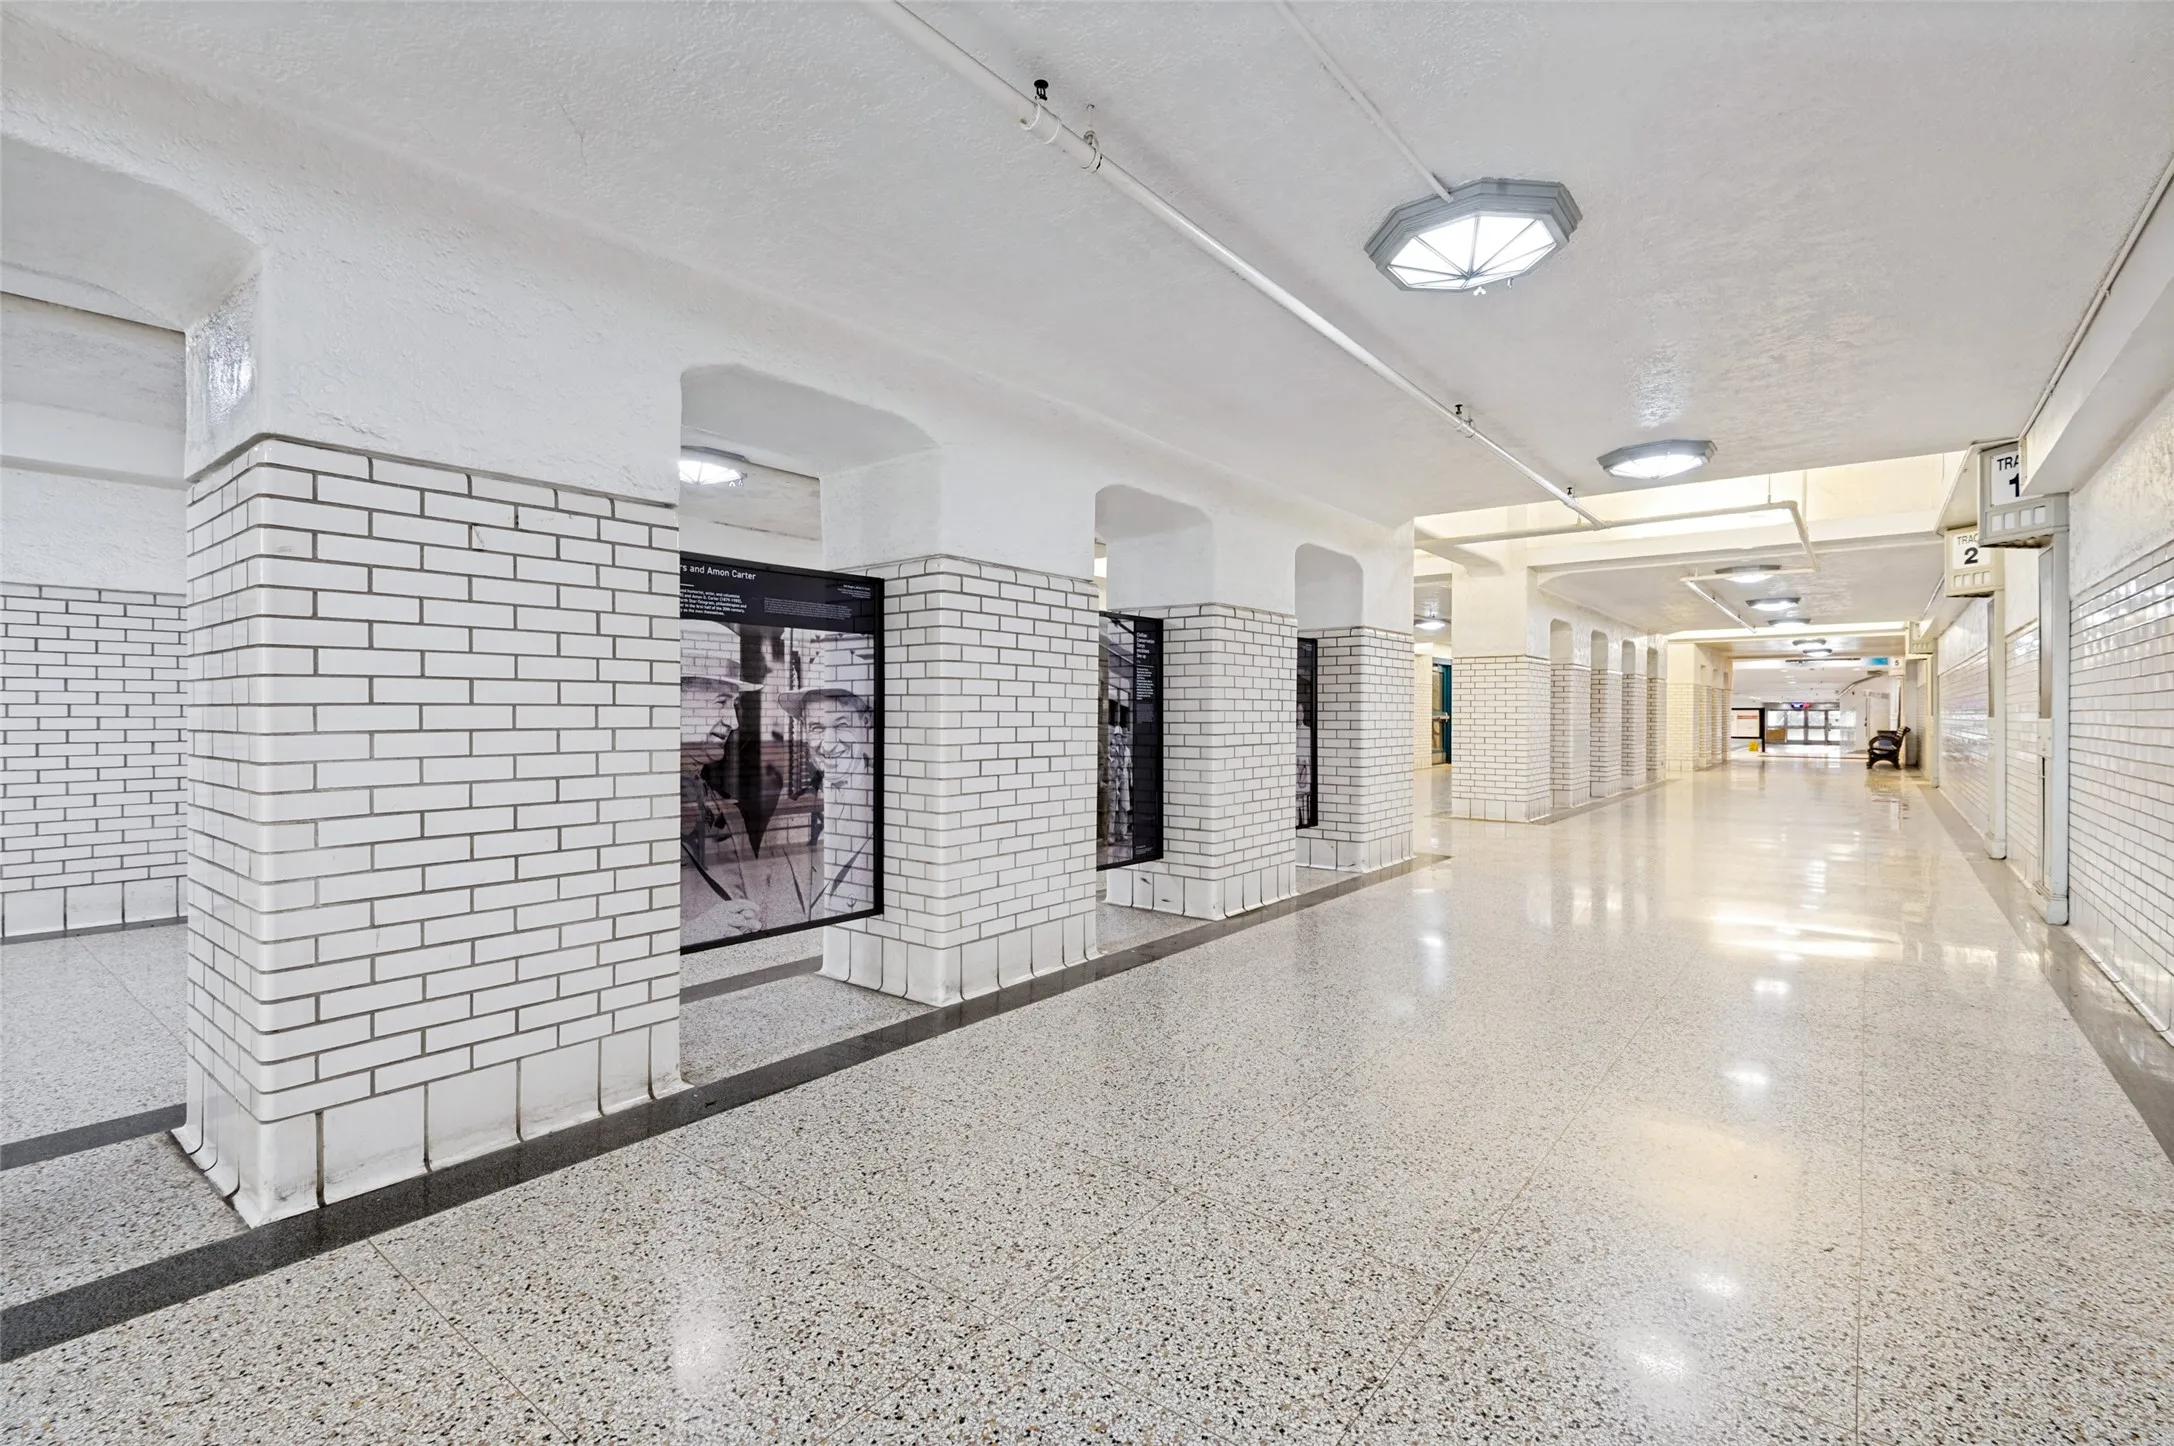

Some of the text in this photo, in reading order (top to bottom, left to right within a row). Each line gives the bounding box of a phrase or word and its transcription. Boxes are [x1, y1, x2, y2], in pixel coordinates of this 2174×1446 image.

[2009, 472, 2020, 497] 1
[1964, 547, 1979, 565] 2
[689, 566, 705, 574] and
[706, 567, 730, 577] Amon
[731, 569, 756, 580] Carter
